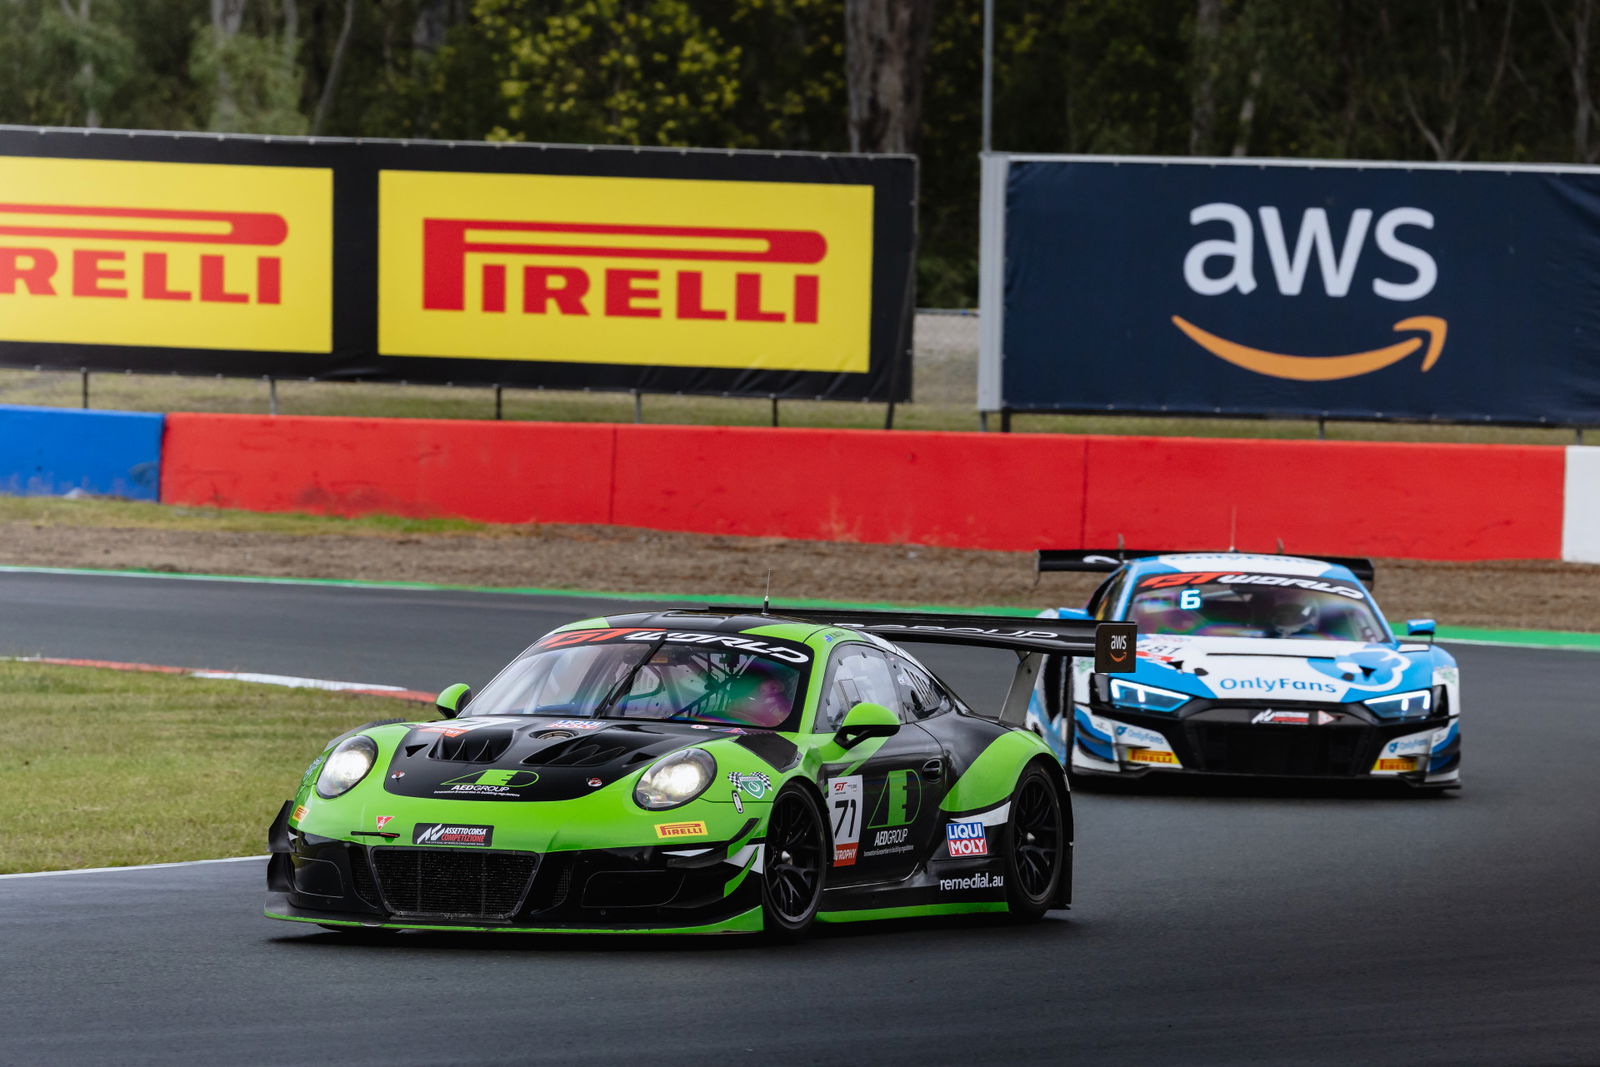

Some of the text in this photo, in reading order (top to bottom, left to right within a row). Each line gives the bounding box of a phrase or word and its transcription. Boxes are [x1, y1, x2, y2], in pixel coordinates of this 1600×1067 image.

[0, 204, 288, 305] RELLI
[1183, 202, 1439, 301] aws
[423, 217, 827, 324] PIRELLI
[1180, 588, 1201, 610] 6
[1111, 634, 1127, 650] aws
[1219, 677, 1337, 693] OnlyFans
[835, 799, 857, 839] 71
[660, 823, 703, 836] PIRELLI
[948, 823, 983, 839] LIQUI
[950, 839, 985, 855] MOLY
[940, 872, 1004, 891] remedial.au
